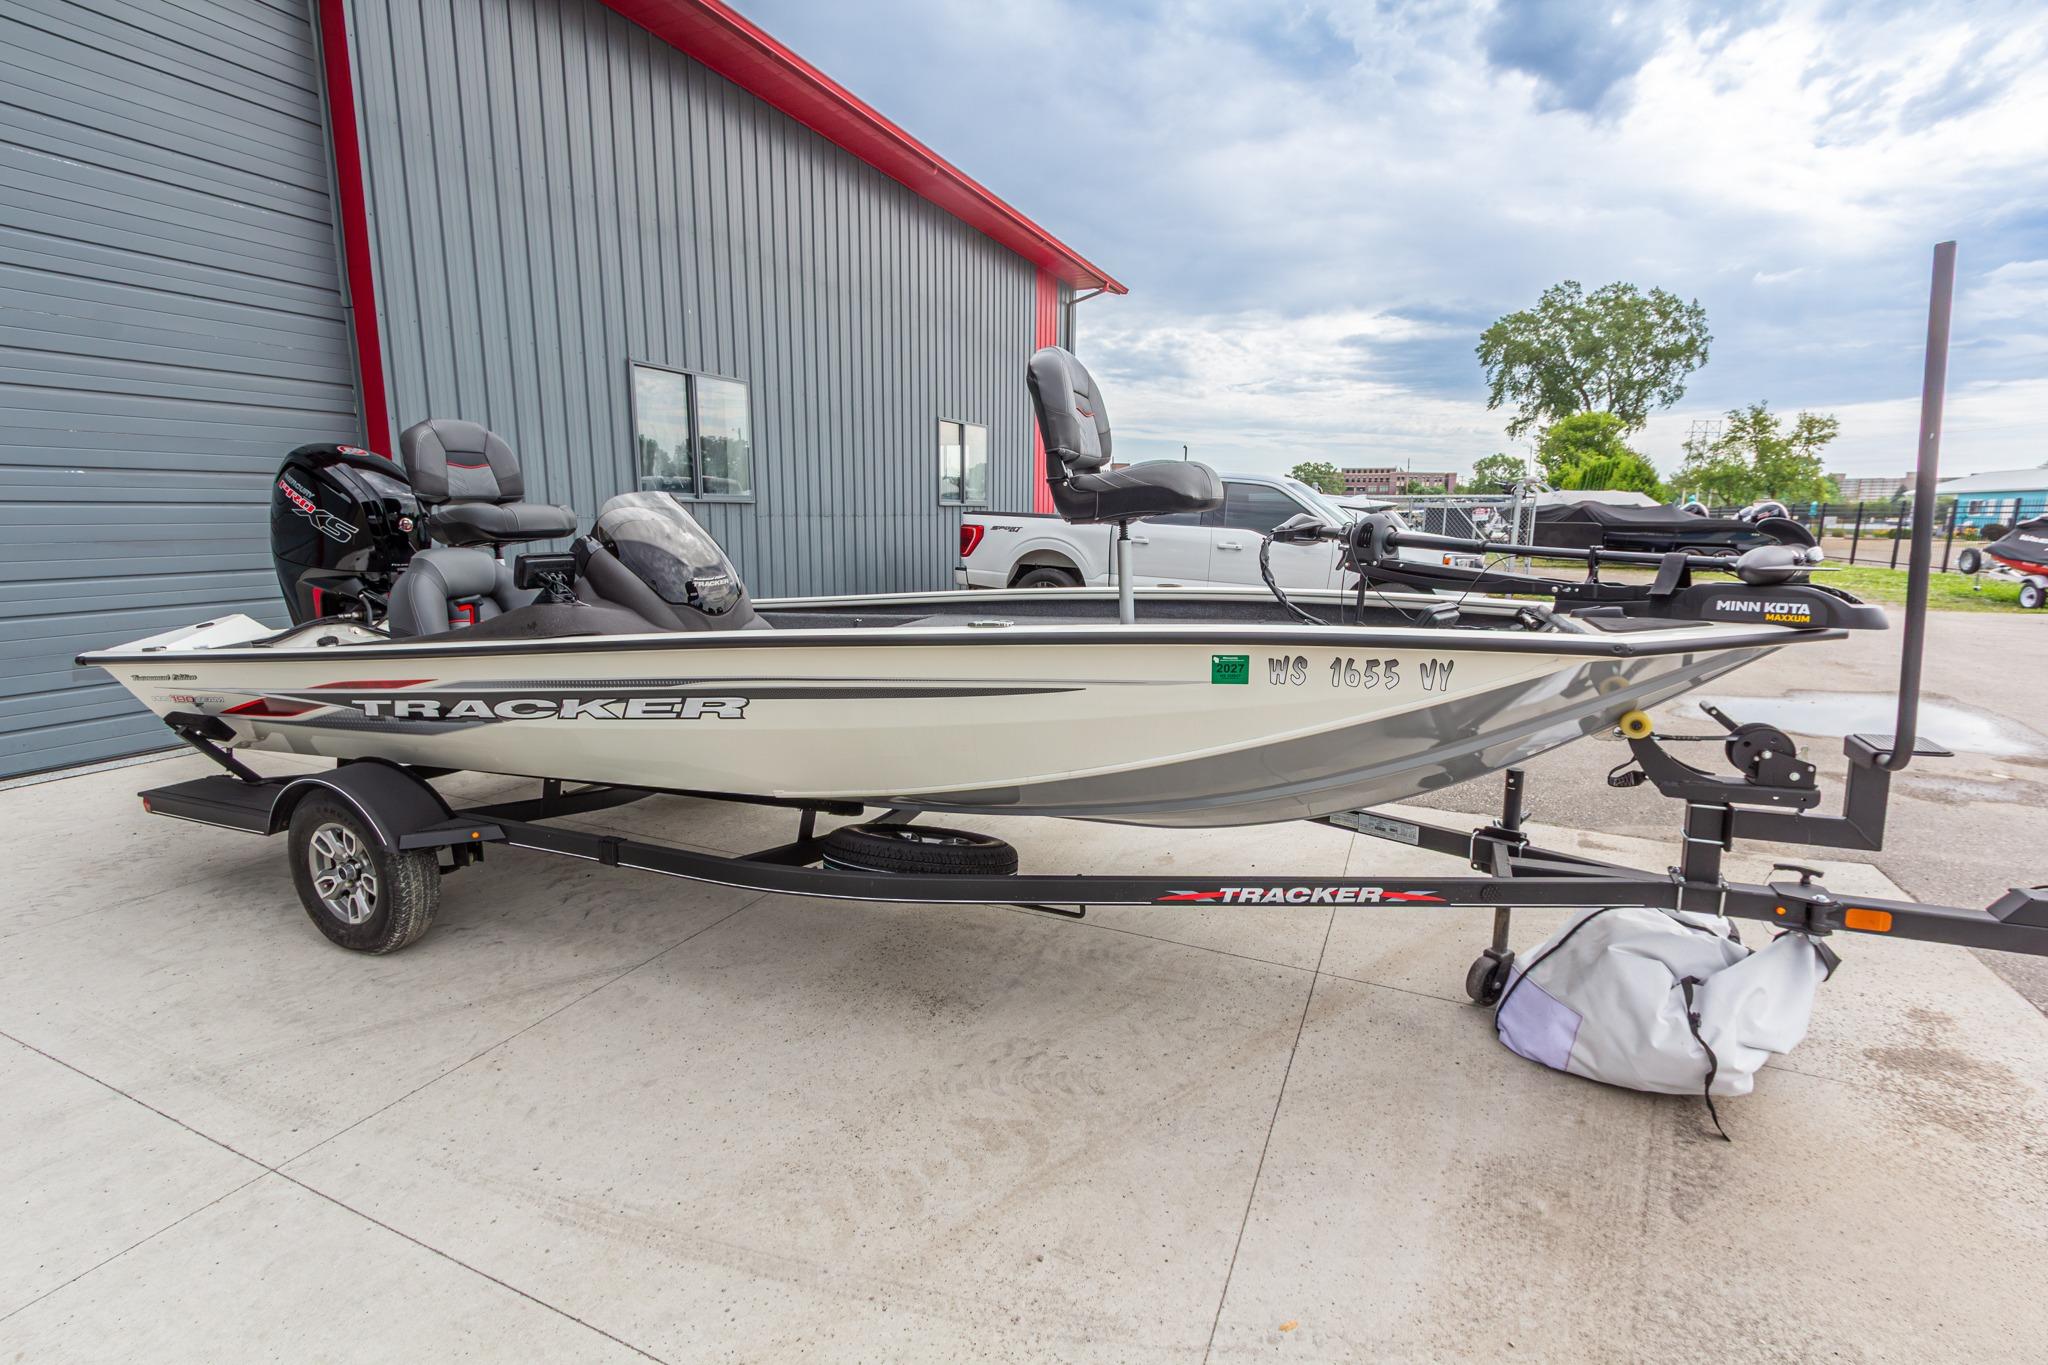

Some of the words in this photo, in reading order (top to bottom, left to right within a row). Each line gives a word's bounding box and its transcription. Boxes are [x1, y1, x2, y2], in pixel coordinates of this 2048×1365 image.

[284, 473, 315, 498] MERCURY
[291, 508, 360, 543] XS
[692, 578, 729, 587] TRACKER
[1715, 600, 1761, 613] MINN
[1763, 602, 1810, 615] KOTA
[1764, 614, 1810, 623] MAXXUM
[1216, 663, 1245, 674] 2027
[1268, 655, 1308, 686] WS
[1330, 657, 1400, 690] 1655
[1419, 659, 1454, 692] VY
[351, 697, 750, 721] TRACKER
[1218, 887, 1384, 903] TRACKER
